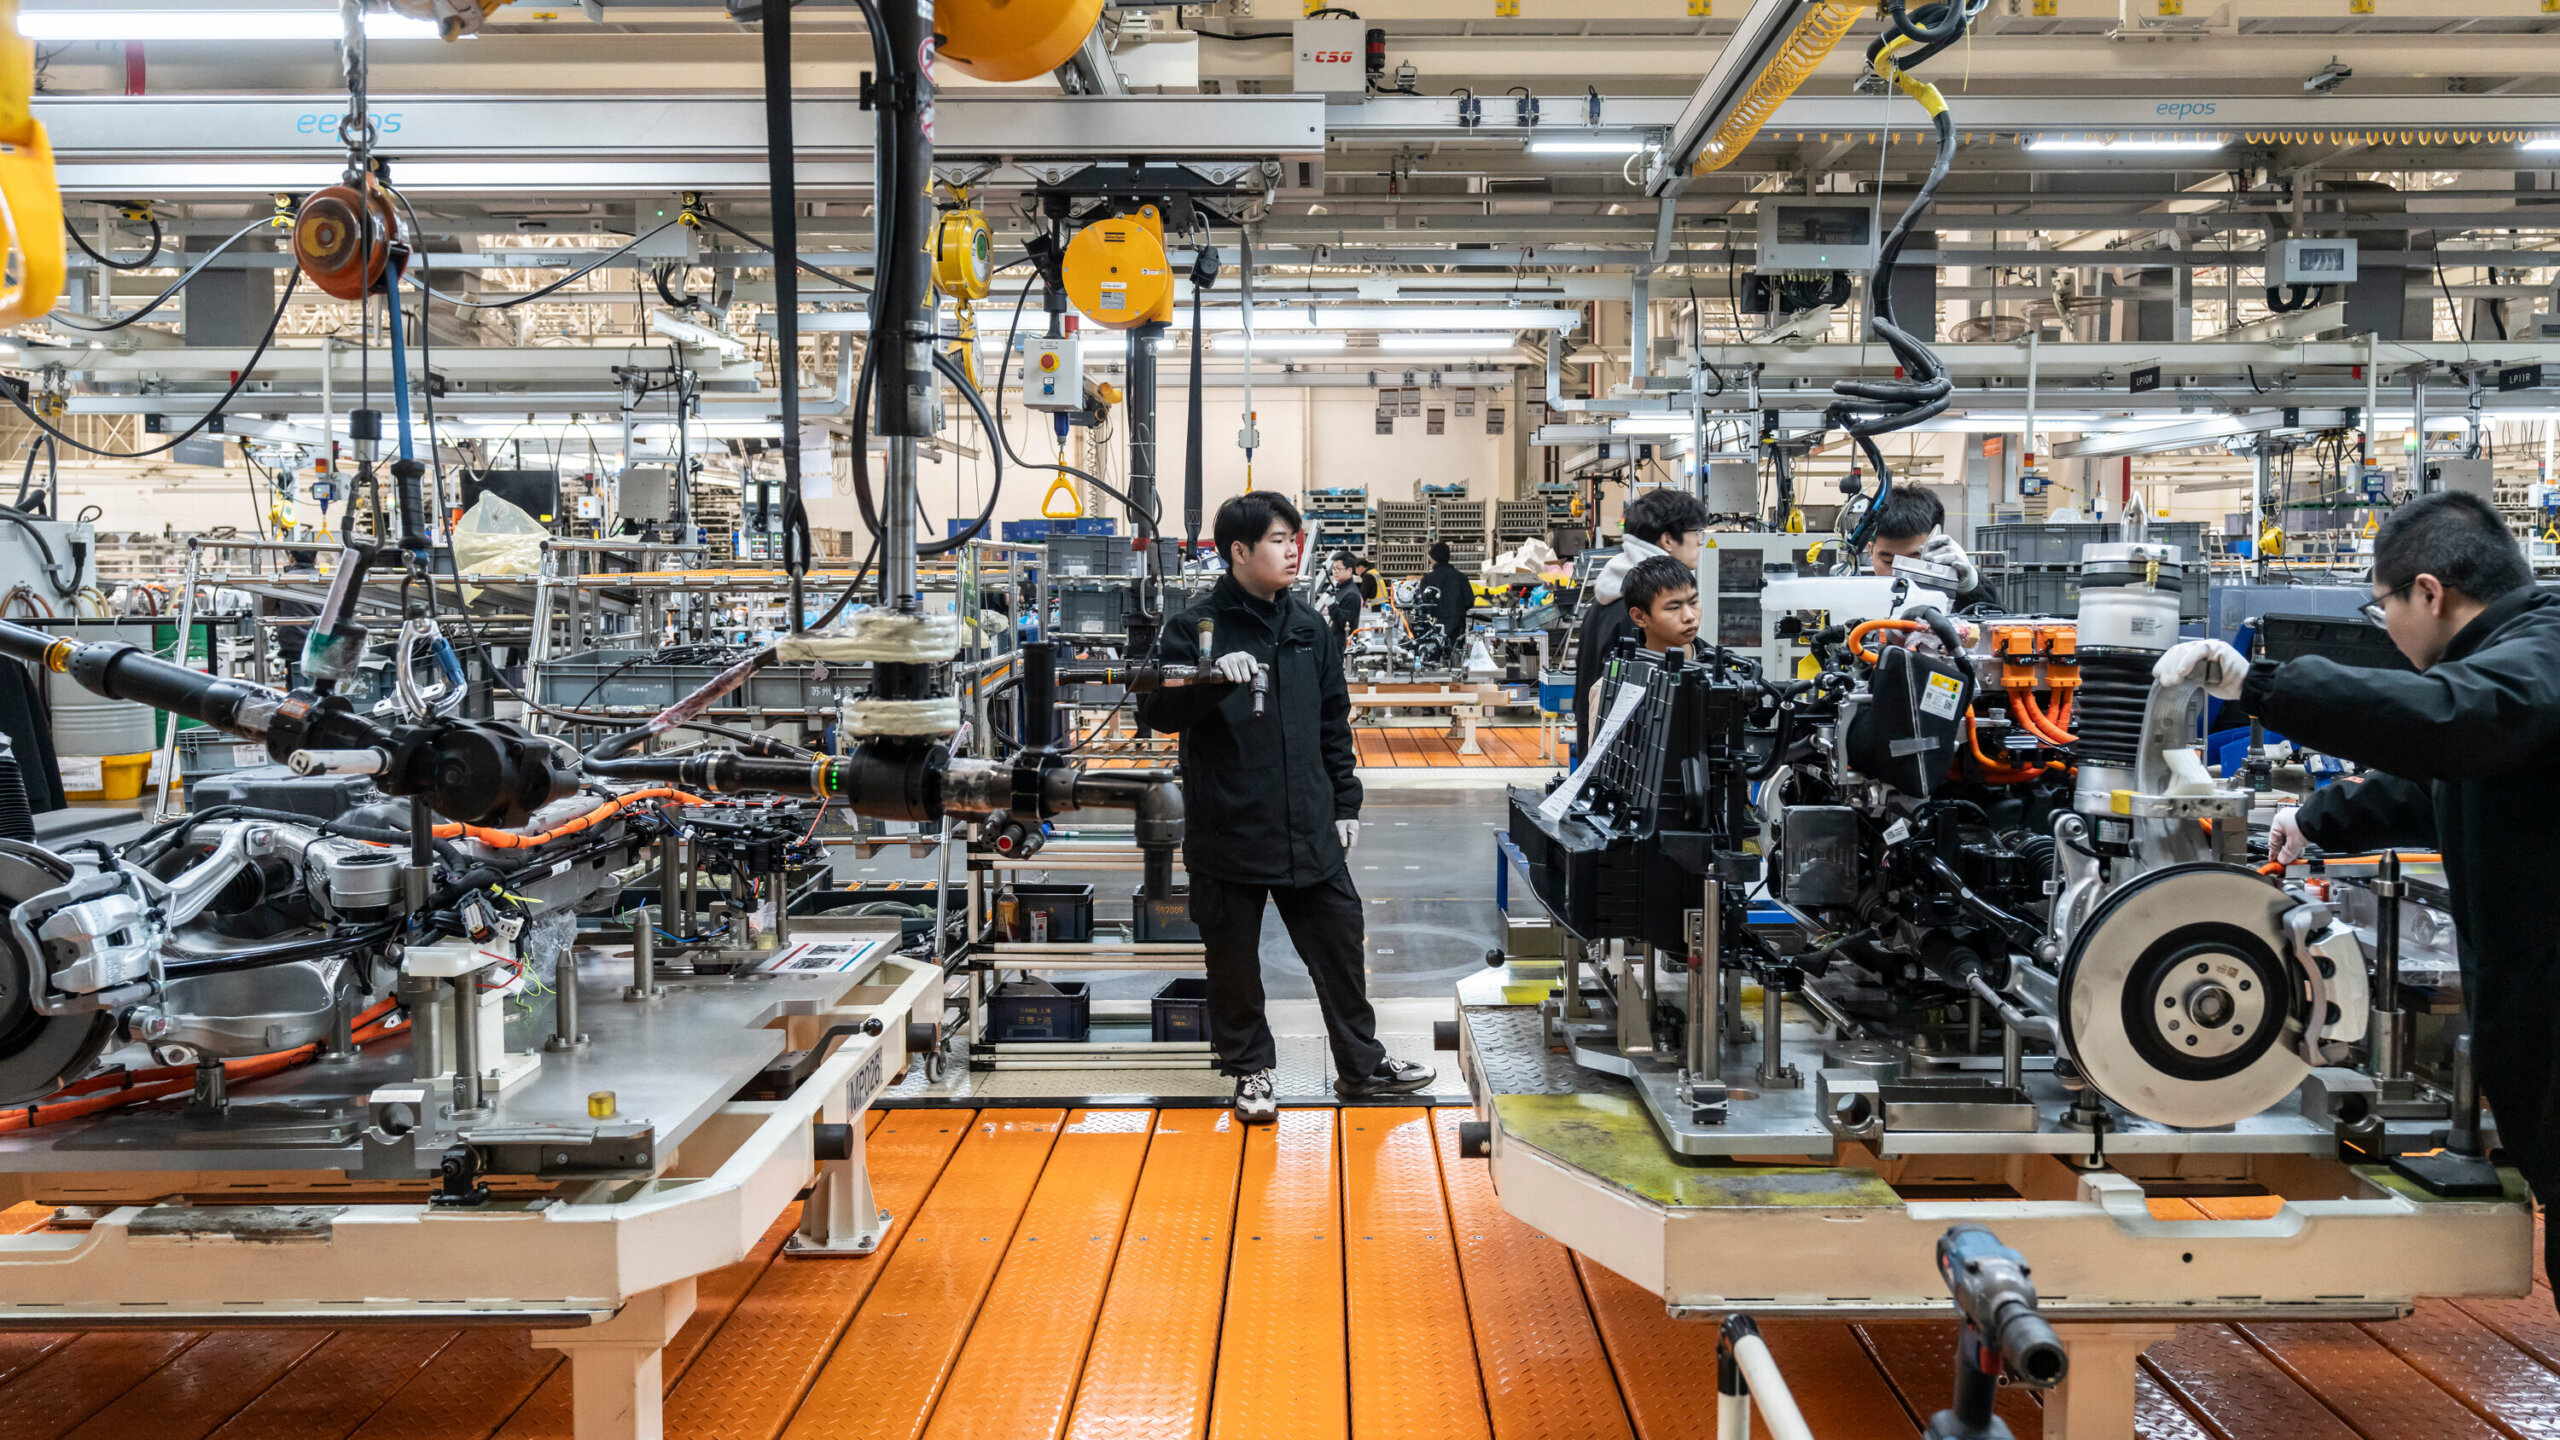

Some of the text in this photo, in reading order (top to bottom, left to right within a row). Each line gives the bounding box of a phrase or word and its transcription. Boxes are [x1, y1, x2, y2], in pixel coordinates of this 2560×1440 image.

[1315, 51, 1353, 63] CSG
[2156, 103, 2216, 120] eepos
[850, 1053, 880, 1114] MP026
